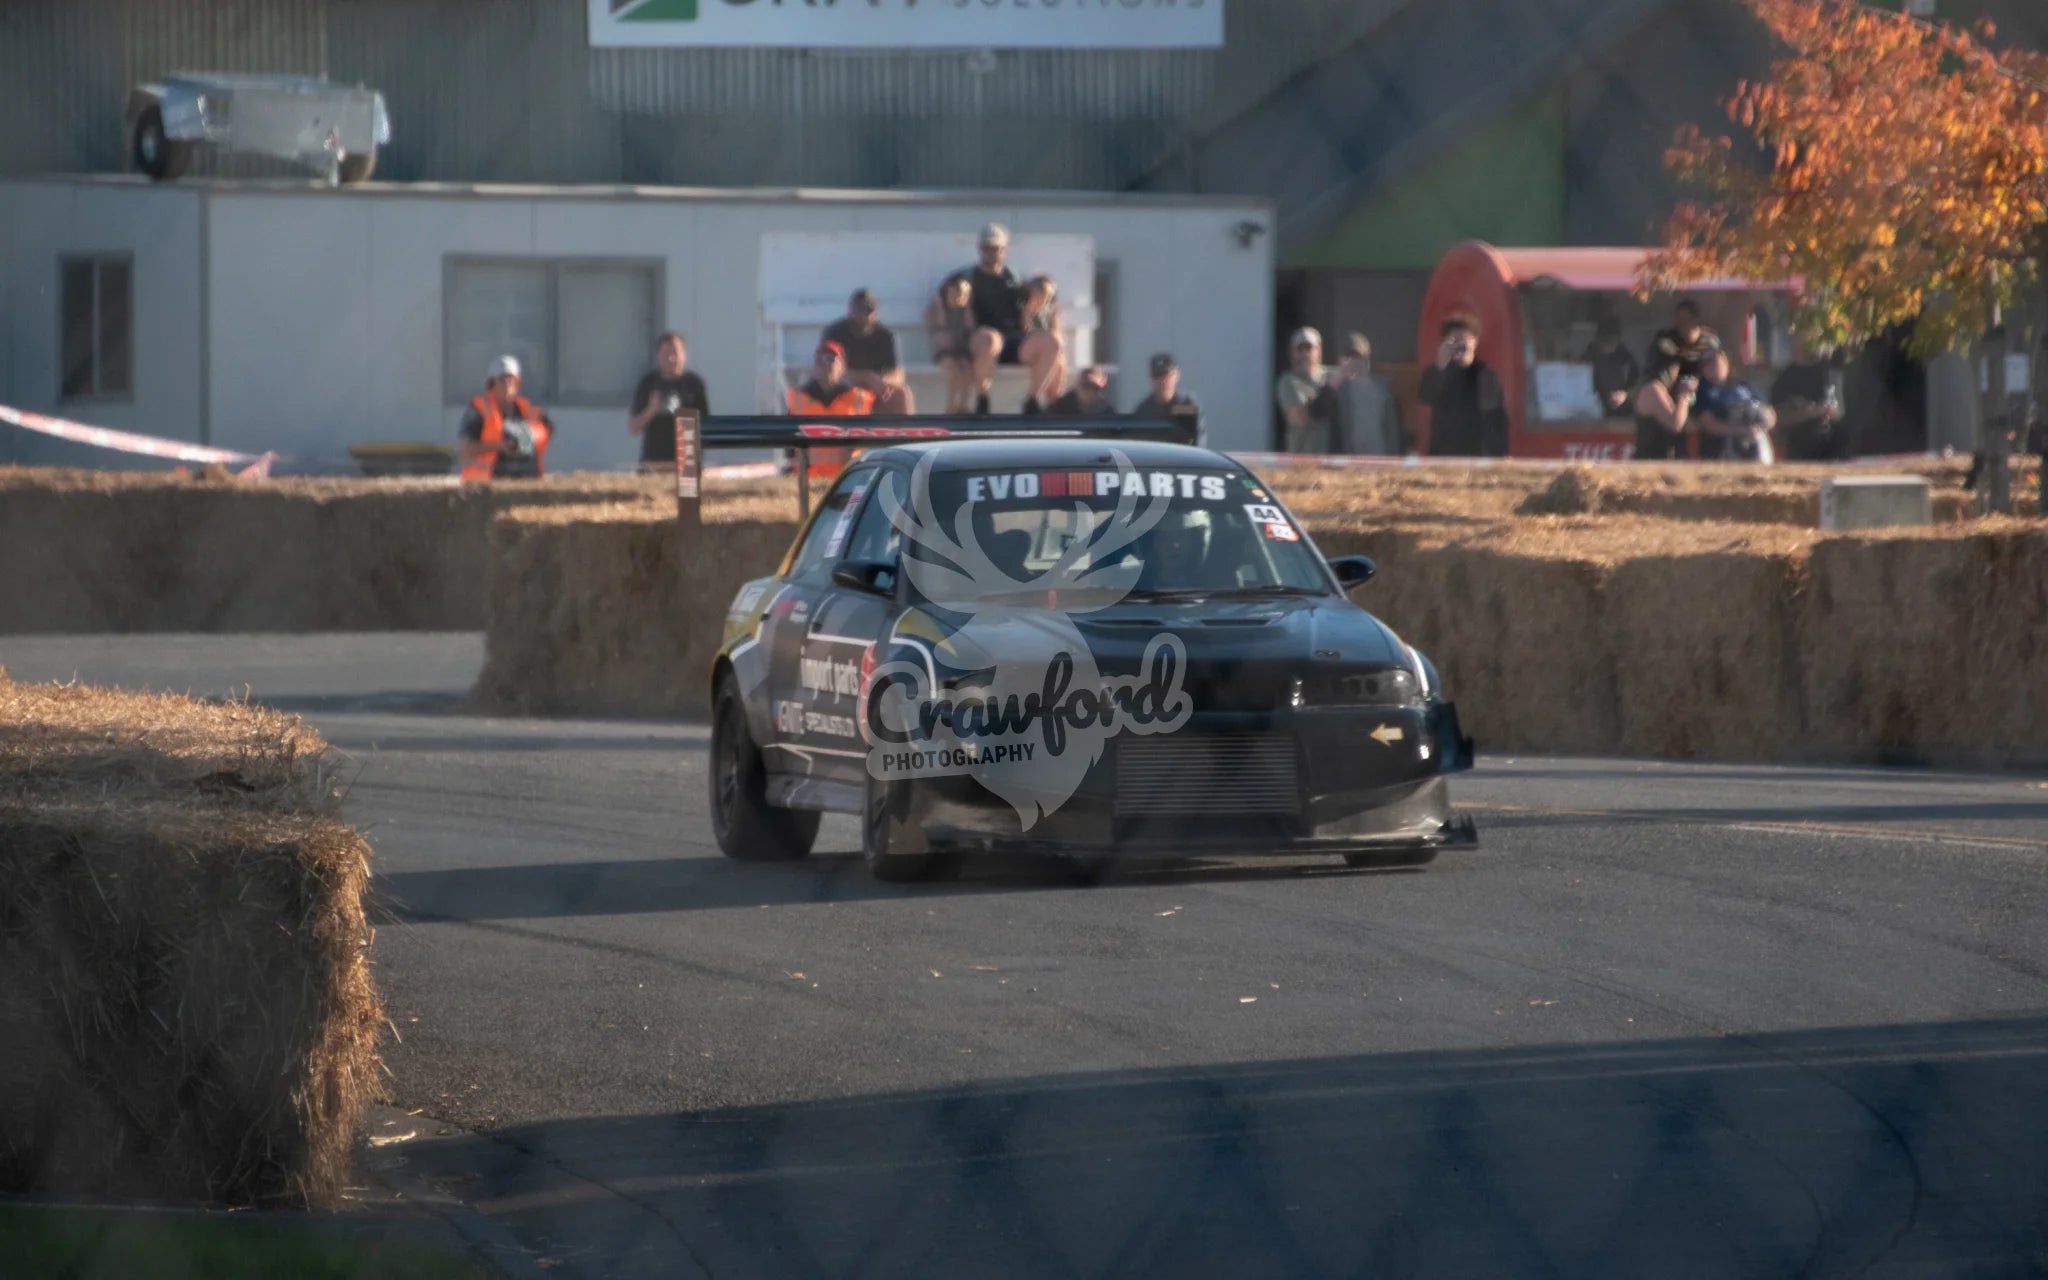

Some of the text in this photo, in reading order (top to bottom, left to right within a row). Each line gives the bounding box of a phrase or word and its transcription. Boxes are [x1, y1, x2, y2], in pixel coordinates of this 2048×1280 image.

[966, 471, 1226, 502] EVO PARTS
[800, 645, 833, 700] import
[834, 658, 858, 704] parts
